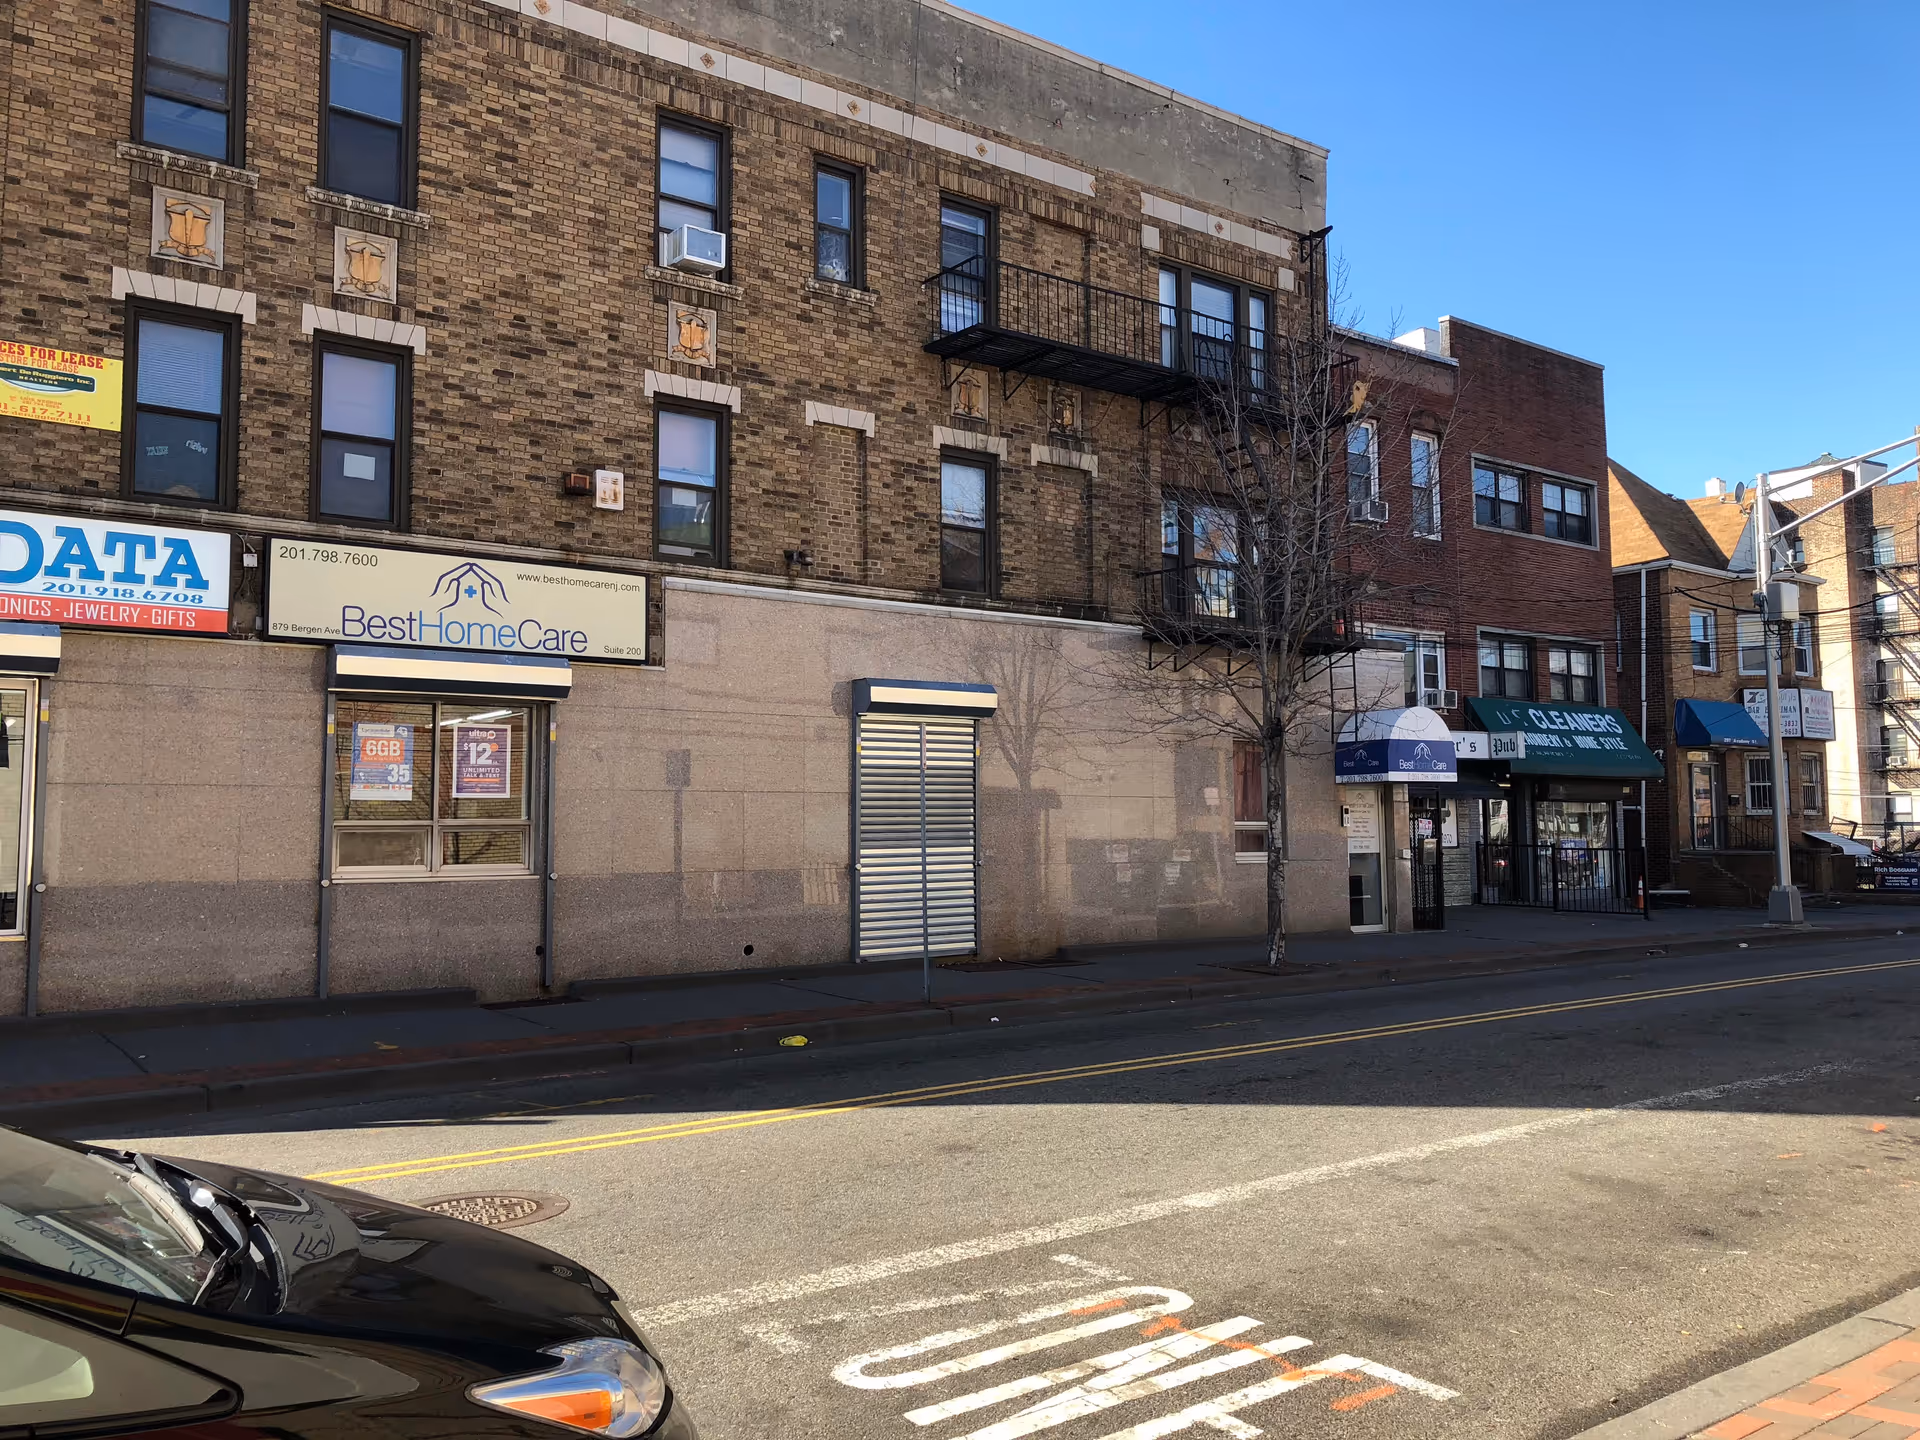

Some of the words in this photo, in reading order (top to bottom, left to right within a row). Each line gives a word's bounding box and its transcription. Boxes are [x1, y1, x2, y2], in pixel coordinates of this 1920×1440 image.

[0, 353, 28, 366] STORE
[31, 357, 48, 369] FOR
[51, 362, 79, 374] LEASE
[30, 346, 56, 361] FOR
[61, 353, 104, 370] LEASE
[18, 375, 59, 385] REALTORS
[0, 402, 91, 422] 1-617-7111
[0, 520, 210, 590] DATA
[279, 545, 378, 568] 201.798.7600
[516, 571, 641, 593] www.besthomecarenj.com
[42, 581, 204, 605] 201.918.6708
[64, 601, 141, 625] JEWELRY
[152, 607, 196, 628] GIFTS
[272, 622, 290, 633] 879
[291, 623, 323, 637] Bergen
[323, 625, 341, 636] Ave
[342, 605, 588, 653] BestHomeCare
[603, 645, 624, 656] Suite
[625, 646, 642, 656] 200
[1747, 706, 1760, 714] DAR
[1528, 708, 1624, 734] CLEANERS
[365, 740, 401, 757] 6GB
[1493, 737, 1516, 756] Pub
[1522, 731, 1564, 748] AUNDERY
[1564, 737, 1572, 748] &
[1572, 735, 1602, 750] HOME
[1600, 737, 1628, 751] STYLE
[463, 742, 493, 765] $12
